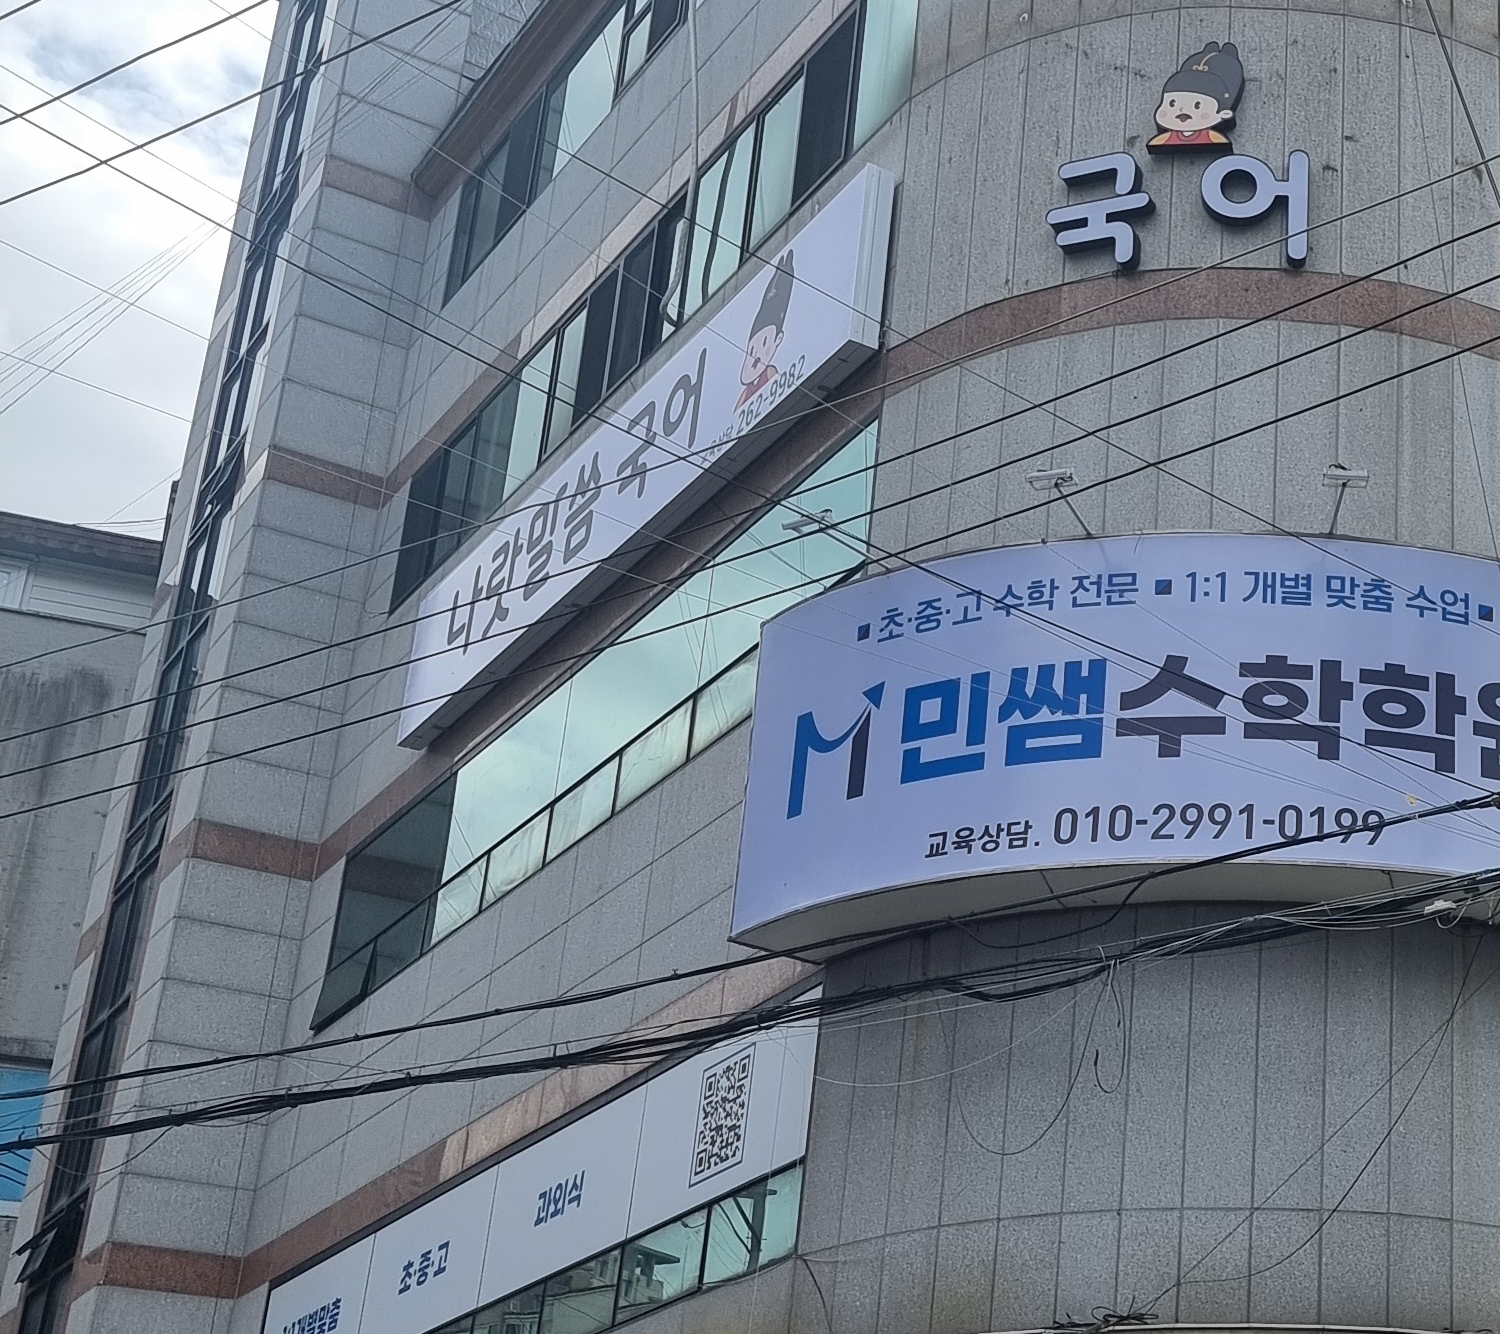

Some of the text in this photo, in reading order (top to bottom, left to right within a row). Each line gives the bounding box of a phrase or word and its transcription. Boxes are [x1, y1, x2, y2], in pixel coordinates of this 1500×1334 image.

[1046, 149, 1310, 267] 국어
[736, 354, 806, 433] 262-9982
[446, 348, 707, 655] 나랏말씀 국어
[994, 578, 1059, 616] 수학
[1071, 572, 1138, 608] 전문
[1186, 571, 1229, 603] 1:1
[1242, 571, 1313, 607] 개별
[1325, 574, 1394, 615] 맞춤
[1406, 585, 1472, 626] 수업
[1054, 802, 1385, 847] 010-2991-0199
[534, 1170, 586, 1228] 과외식
